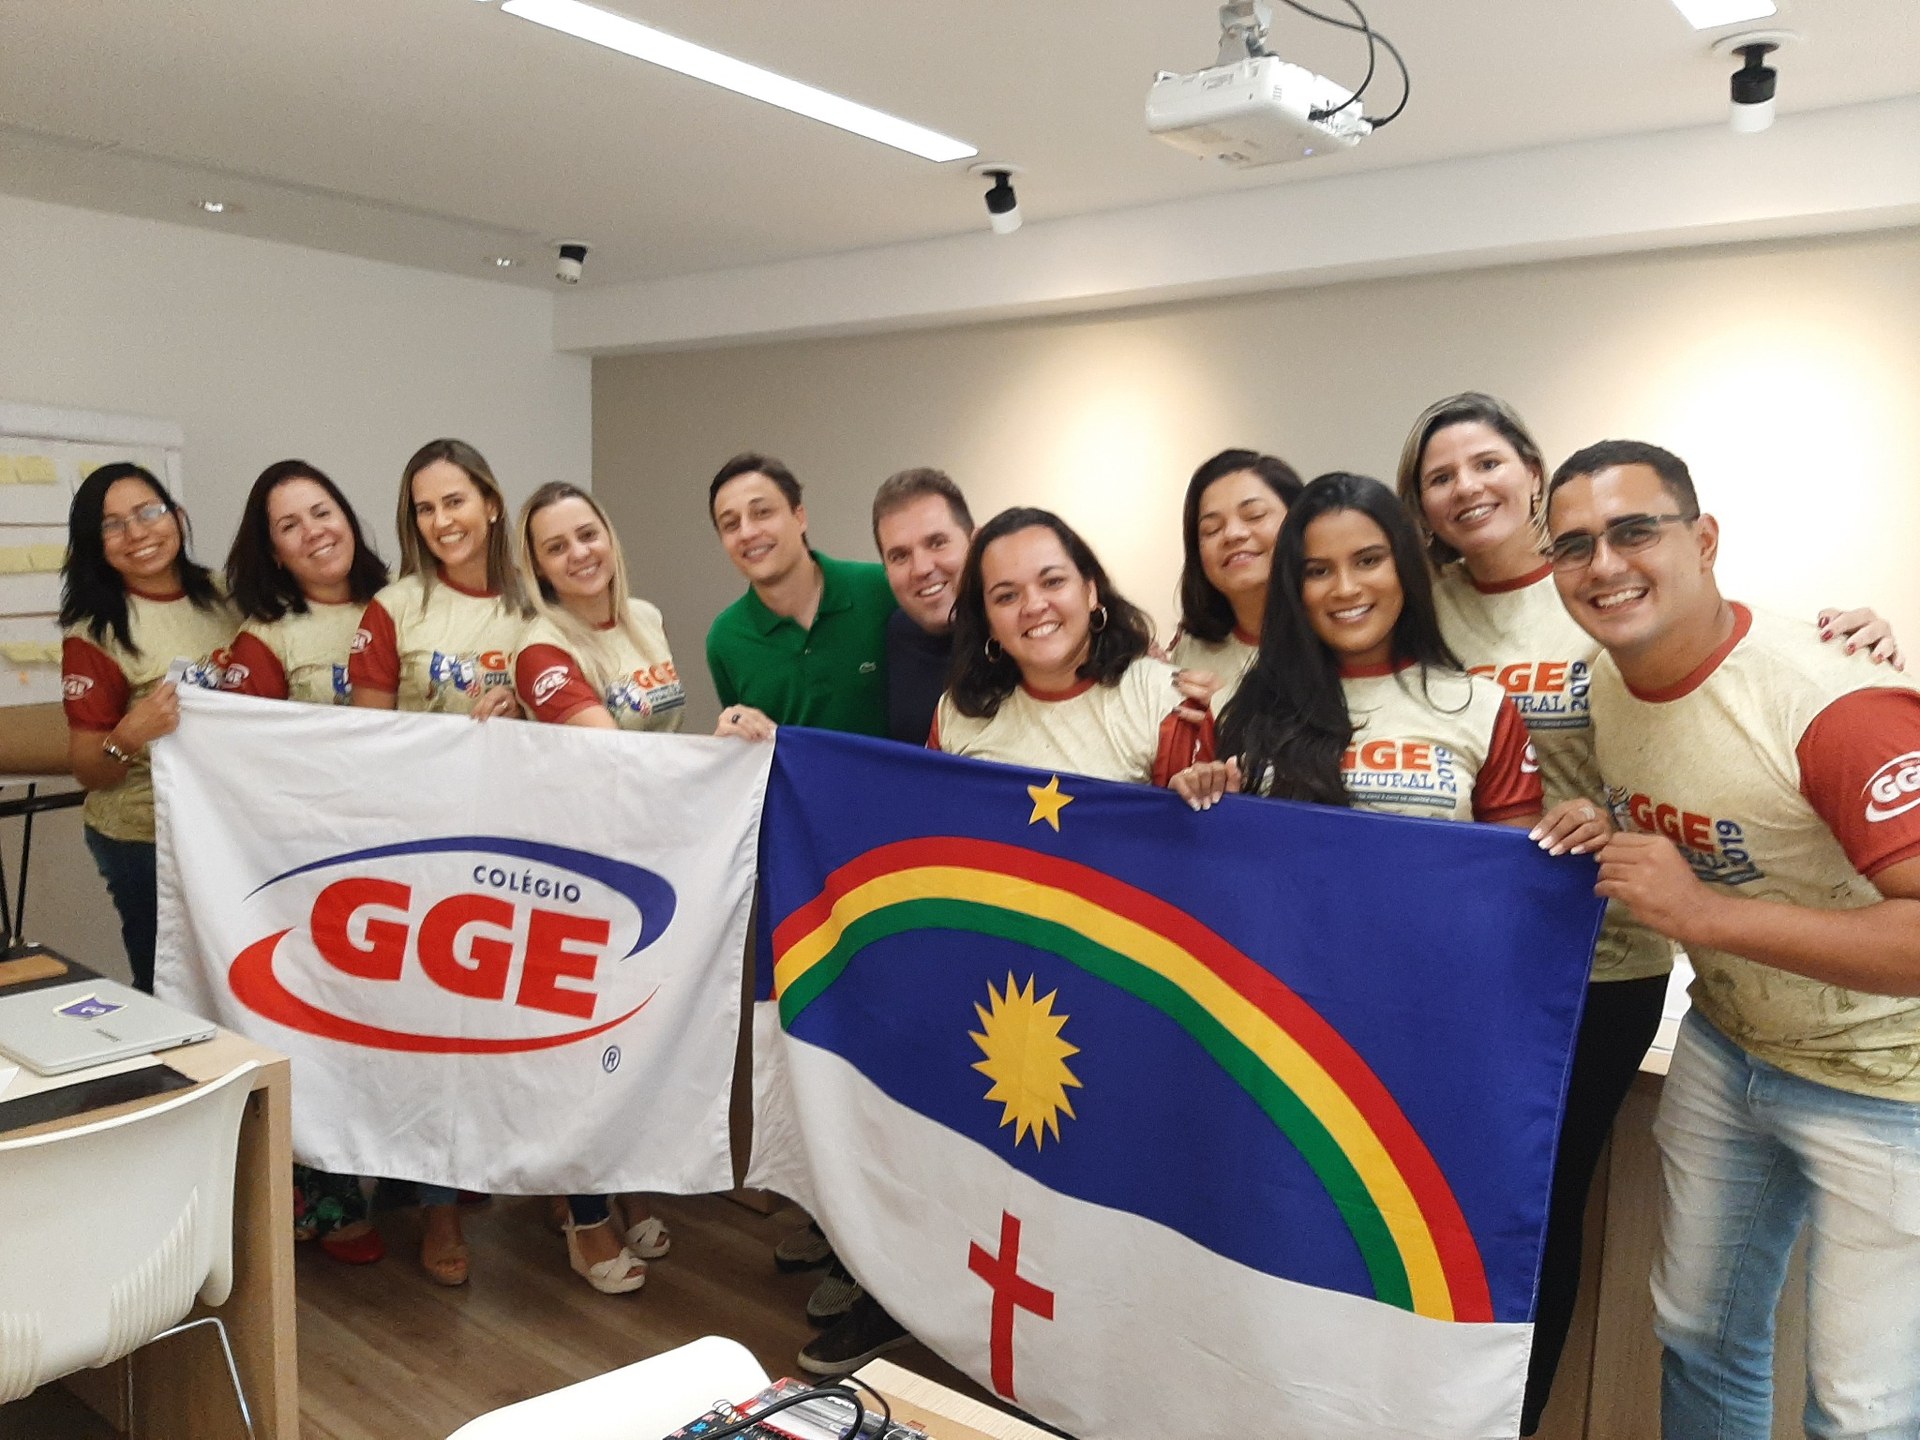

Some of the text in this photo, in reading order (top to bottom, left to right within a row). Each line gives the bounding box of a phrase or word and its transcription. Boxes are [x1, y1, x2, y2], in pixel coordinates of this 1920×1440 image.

[1570, 661, 1589, 711] 2019
[1435, 745, 1457, 793] 2019
[1629, 793, 1715, 852] GGE
[472, 865, 582, 903] COLÉGIO
[310, 877, 611, 1021] GGE
